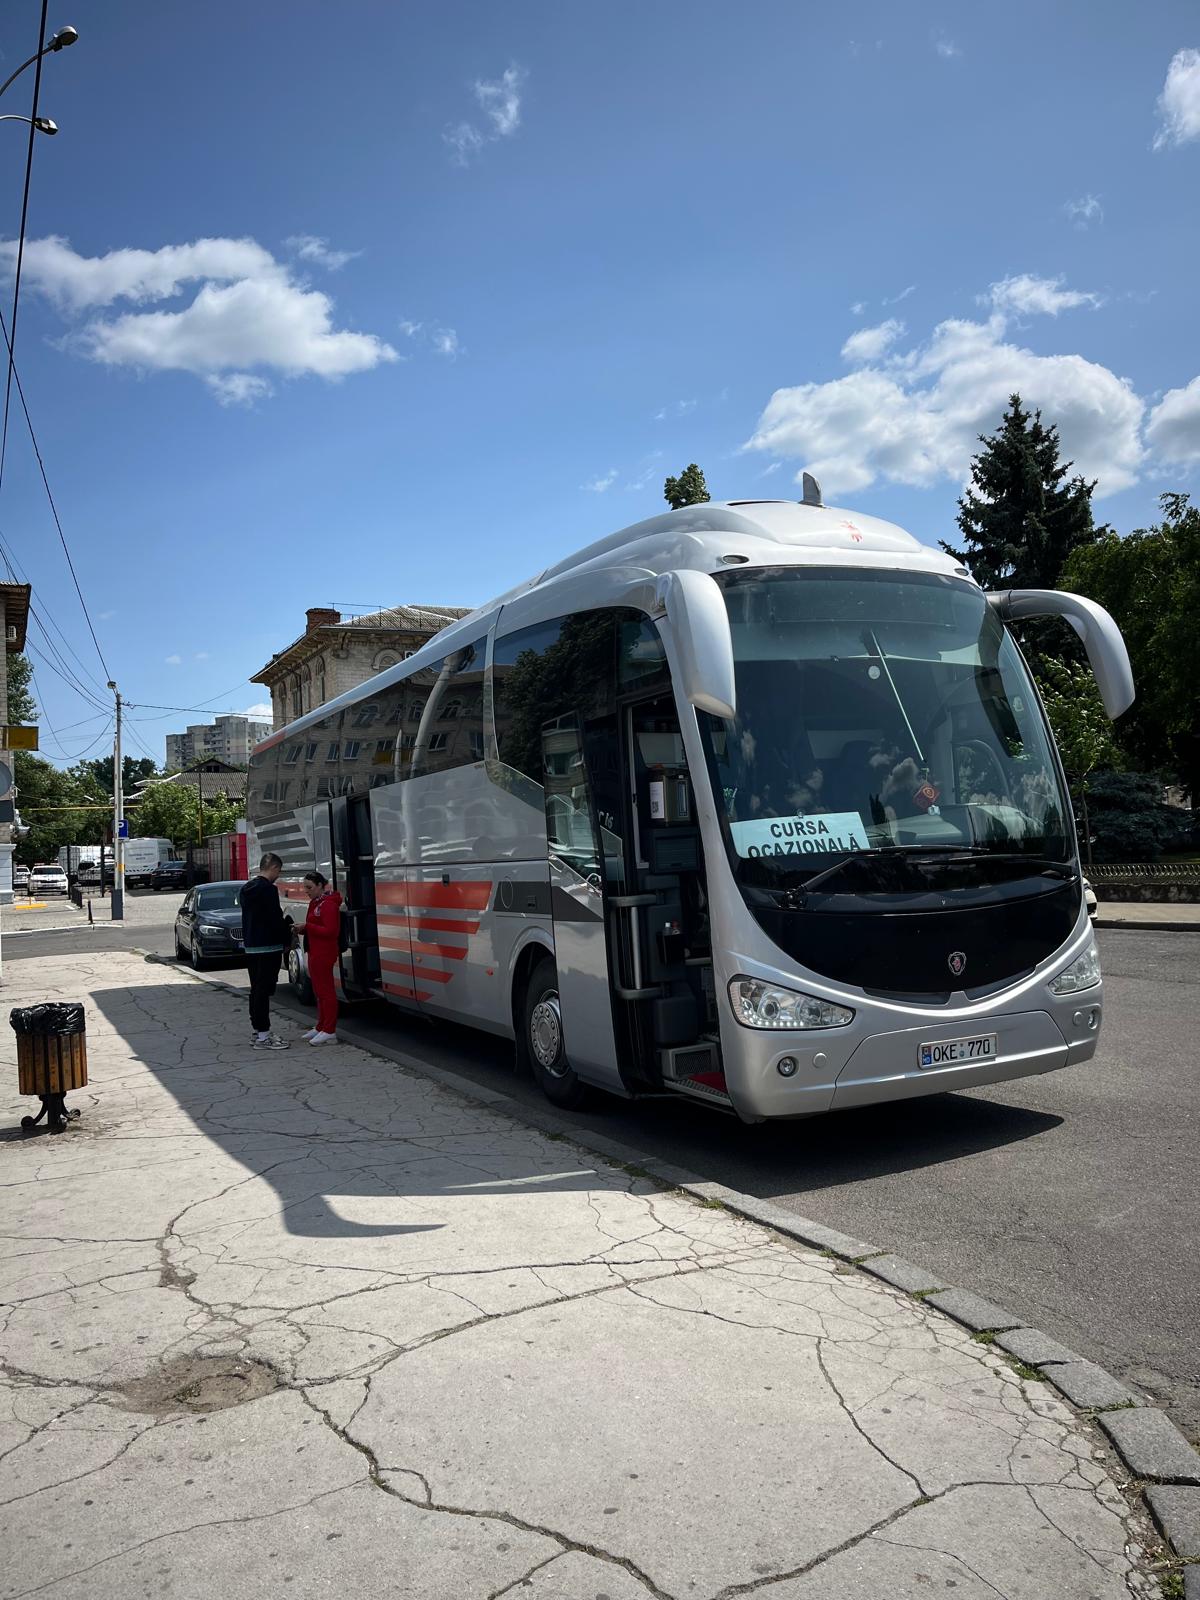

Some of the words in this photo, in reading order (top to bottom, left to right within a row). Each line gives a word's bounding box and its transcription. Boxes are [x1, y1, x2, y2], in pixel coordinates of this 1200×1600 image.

[117, 822, 124, 832] P
[770, 820, 829, 838] CURSA
[747, 833, 861, 858] OCAZIONALĂ
[933, 1044, 957, 1062] OKE
[968, 1039, 990, 1056] 770
